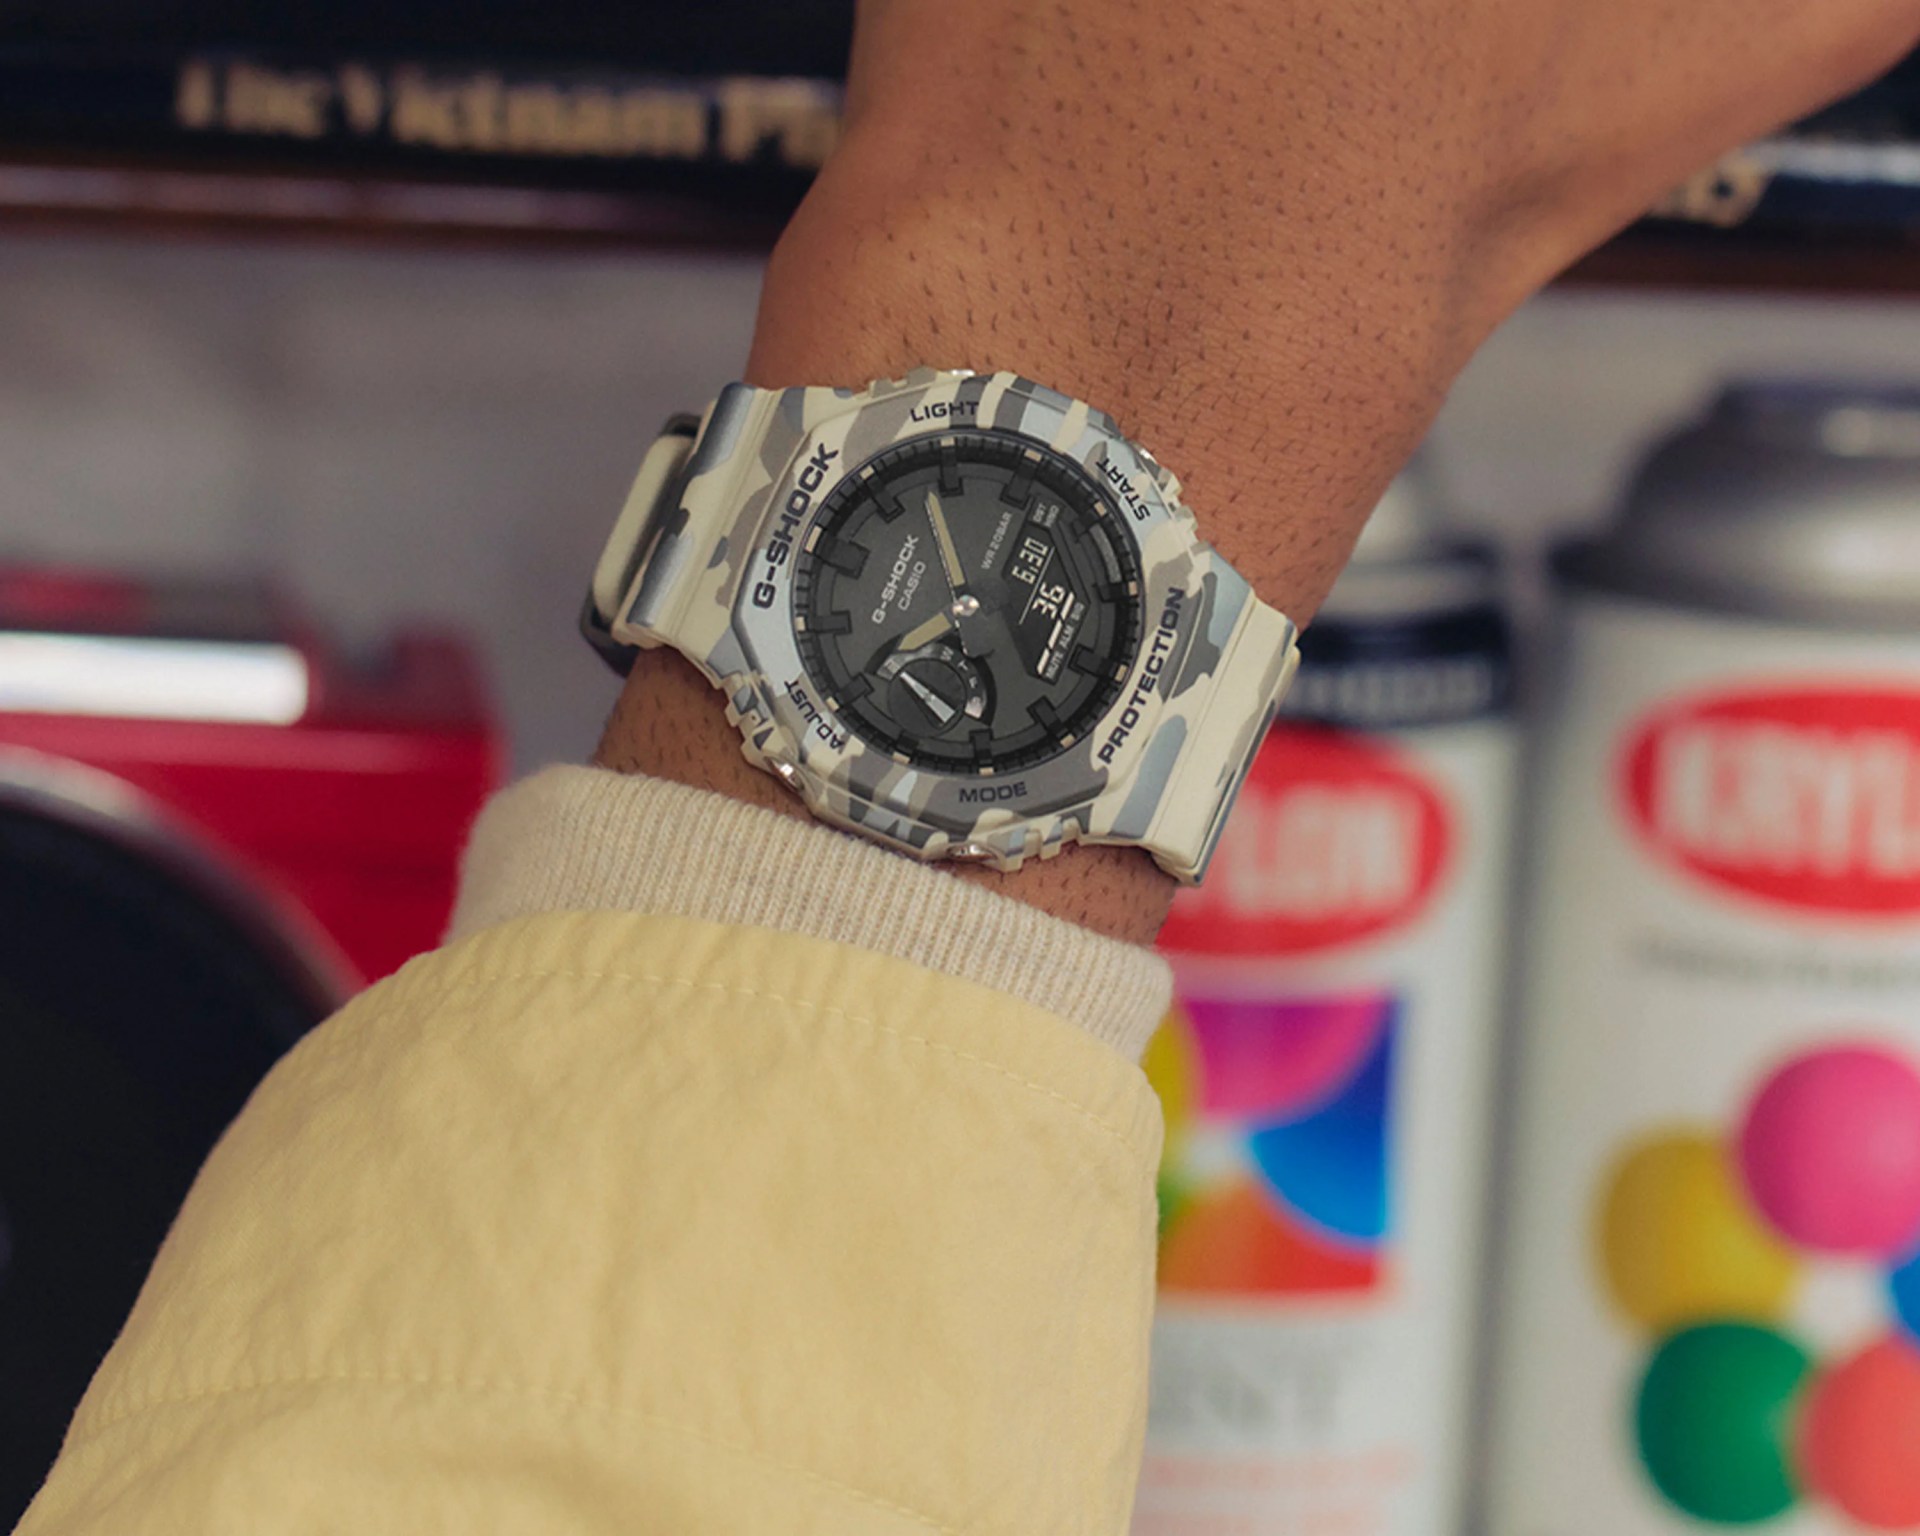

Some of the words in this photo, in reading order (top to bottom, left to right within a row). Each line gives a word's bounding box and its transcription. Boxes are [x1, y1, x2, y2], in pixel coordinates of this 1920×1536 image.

[910, 401, 979, 422] LIGHT
[1096, 458, 1151, 521] START
[752, 443, 839, 609] G-SHOCK
[872, 534, 919, 624] G-SHOCK
[897, 561, 926, 611] CASIO
[1031, 581, 1066, 620] 36
[1097, 586, 1185, 765] PROTECTION
[784, 680, 846, 755] ADJUST
[959, 781, 1028, 803] MODE
